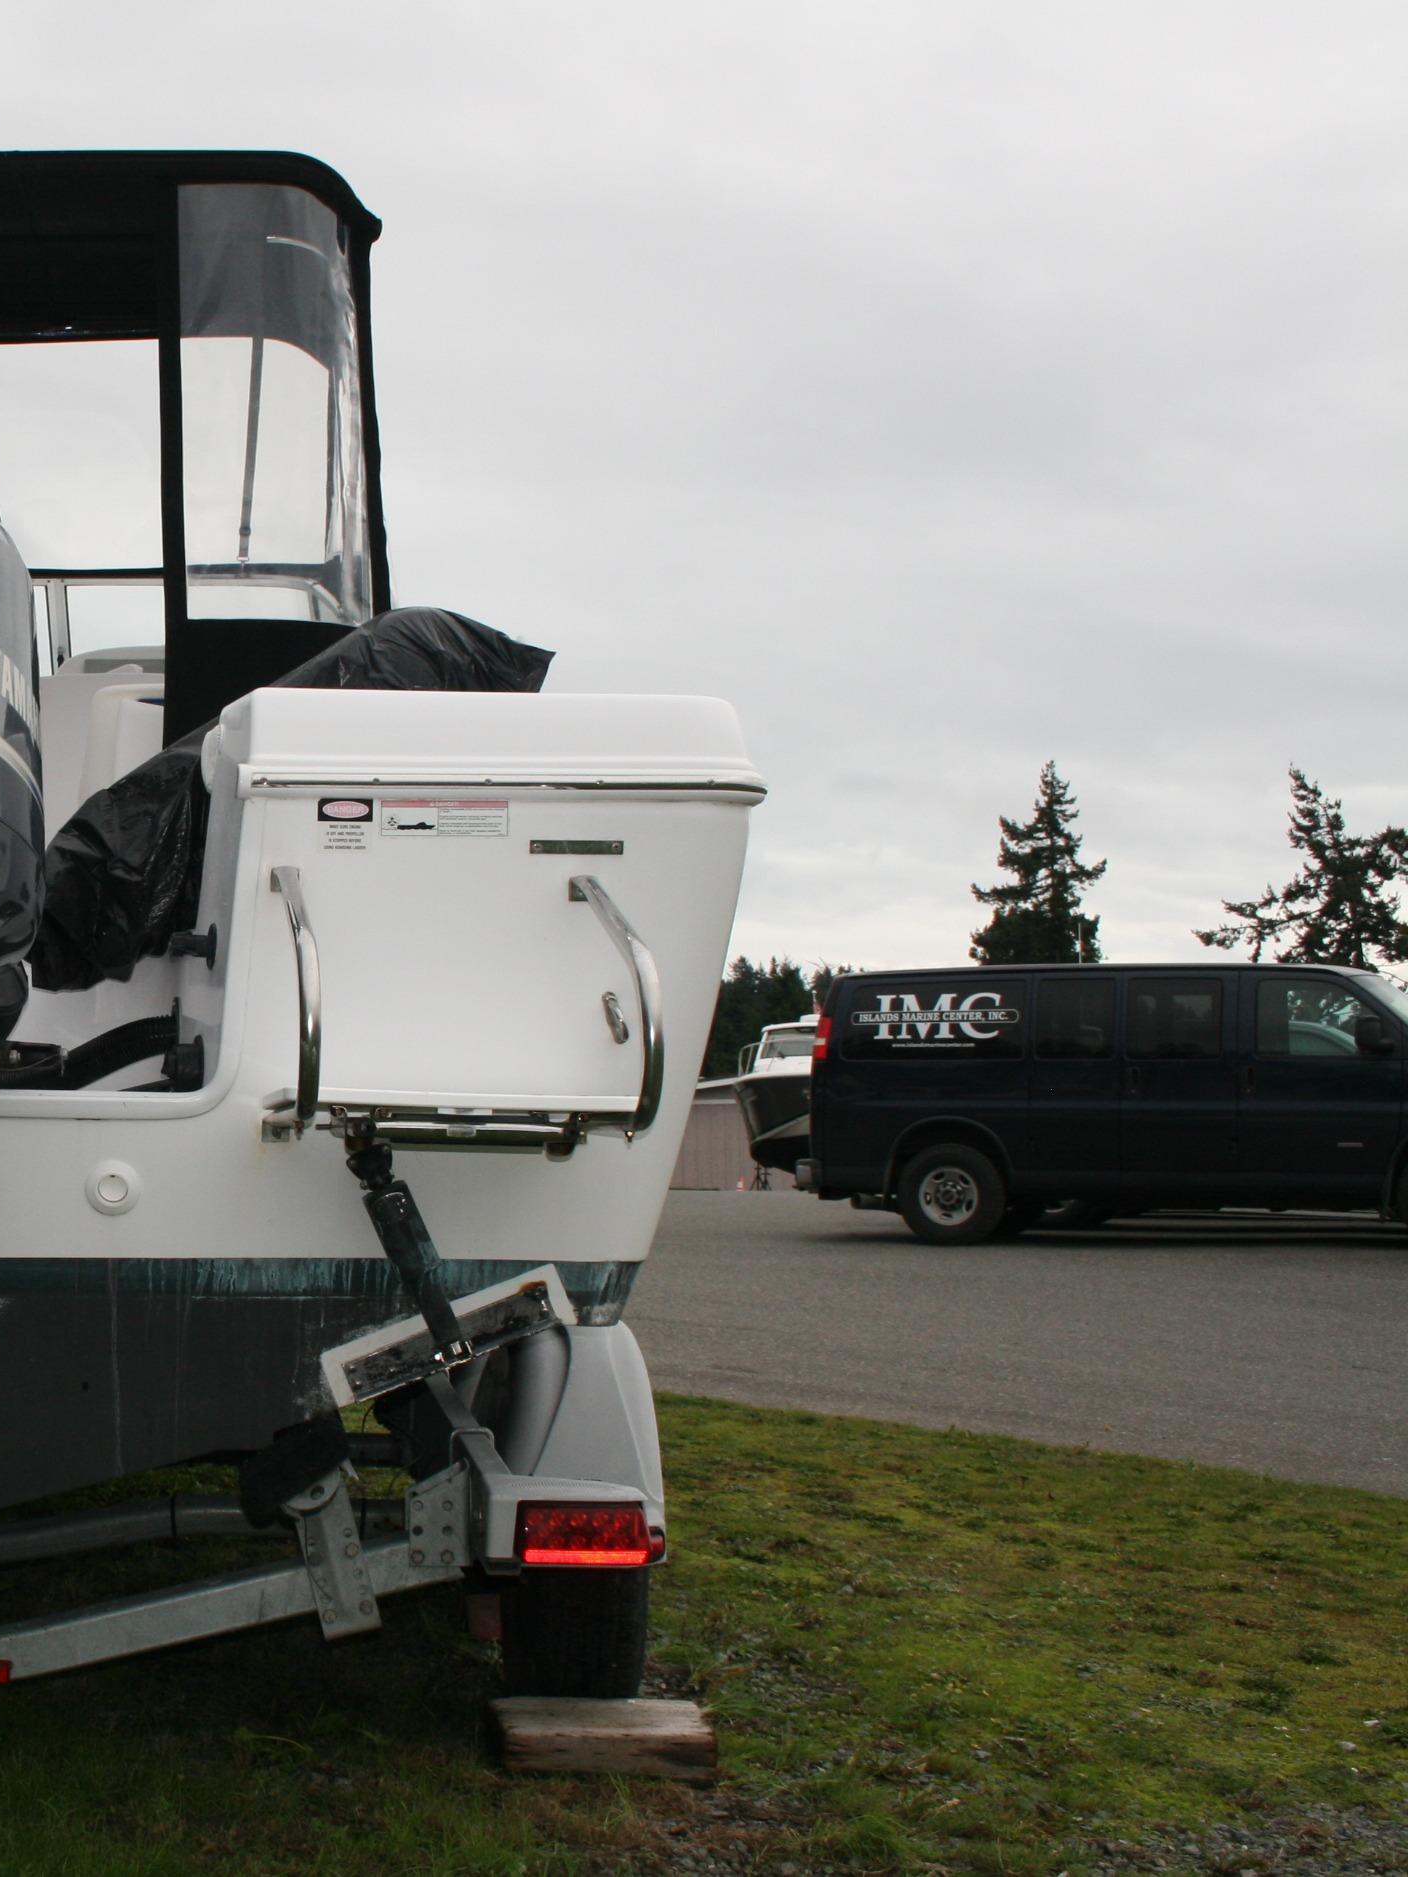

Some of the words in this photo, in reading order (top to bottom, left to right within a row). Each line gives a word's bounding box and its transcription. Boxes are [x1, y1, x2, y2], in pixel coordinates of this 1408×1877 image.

[326, 804, 366, 815] DANGER
[859, 1012, 900, 1023] ISLANDS
[901, 1012, 941, 1022] MARINE
[942, 1011, 986, 1022] CENTER,
[988, 1011, 1009, 1021] INC.
[873, 992, 1002, 1040] IMC
